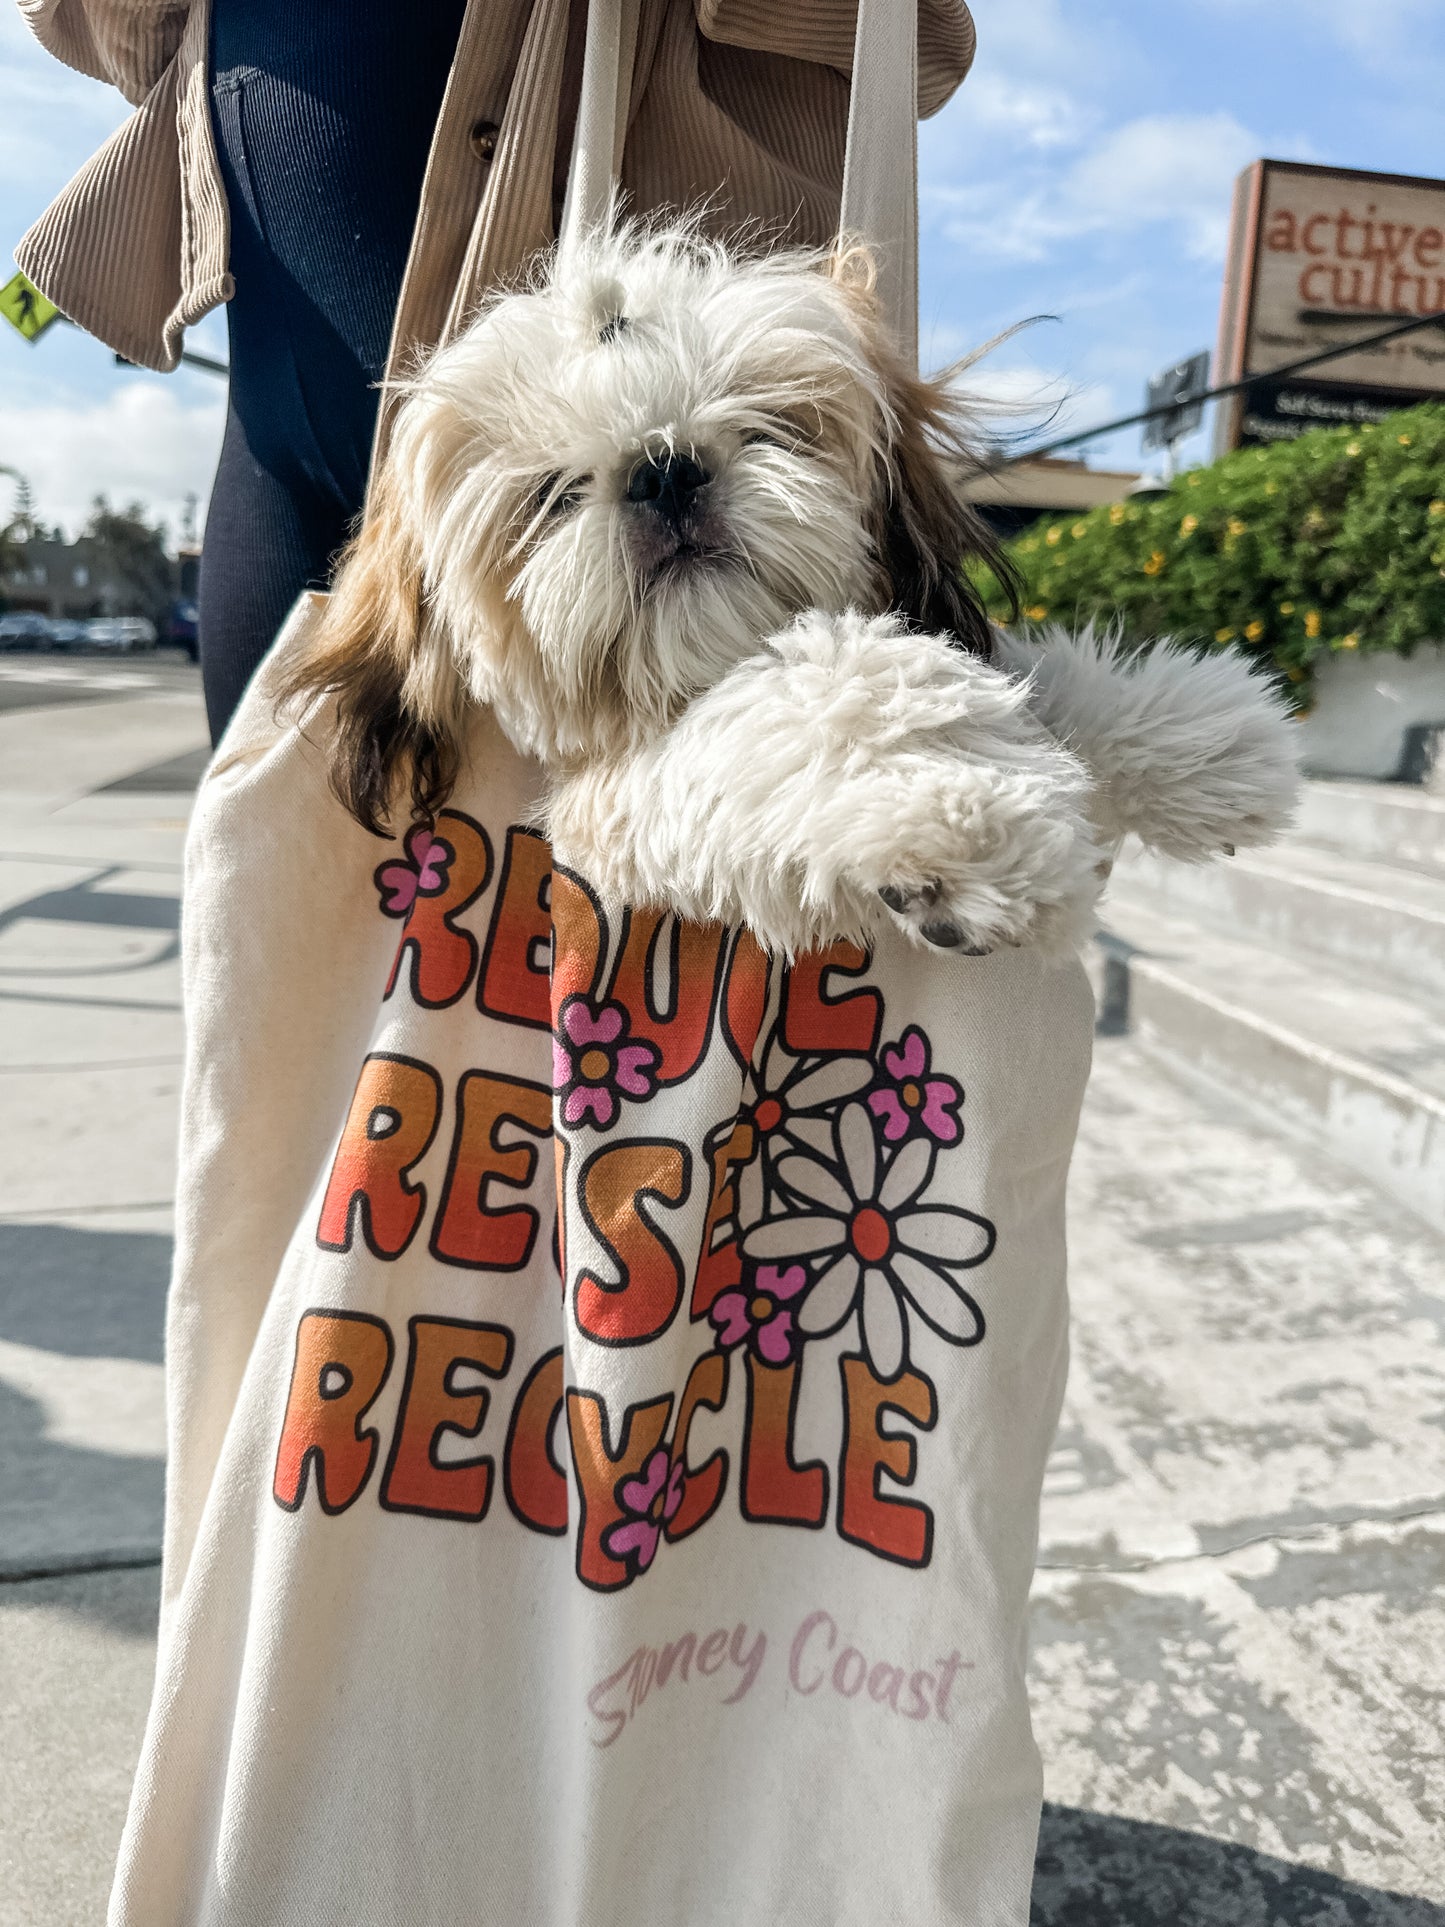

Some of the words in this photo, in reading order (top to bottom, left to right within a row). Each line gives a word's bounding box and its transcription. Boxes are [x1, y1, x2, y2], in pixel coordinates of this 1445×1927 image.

[1264, 204, 1443, 268] active
[316, 1052, 757, 1347] RESE
[273, 1308, 938, 1592] RECYCLE
[788, 1610, 976, 1725] Coast
